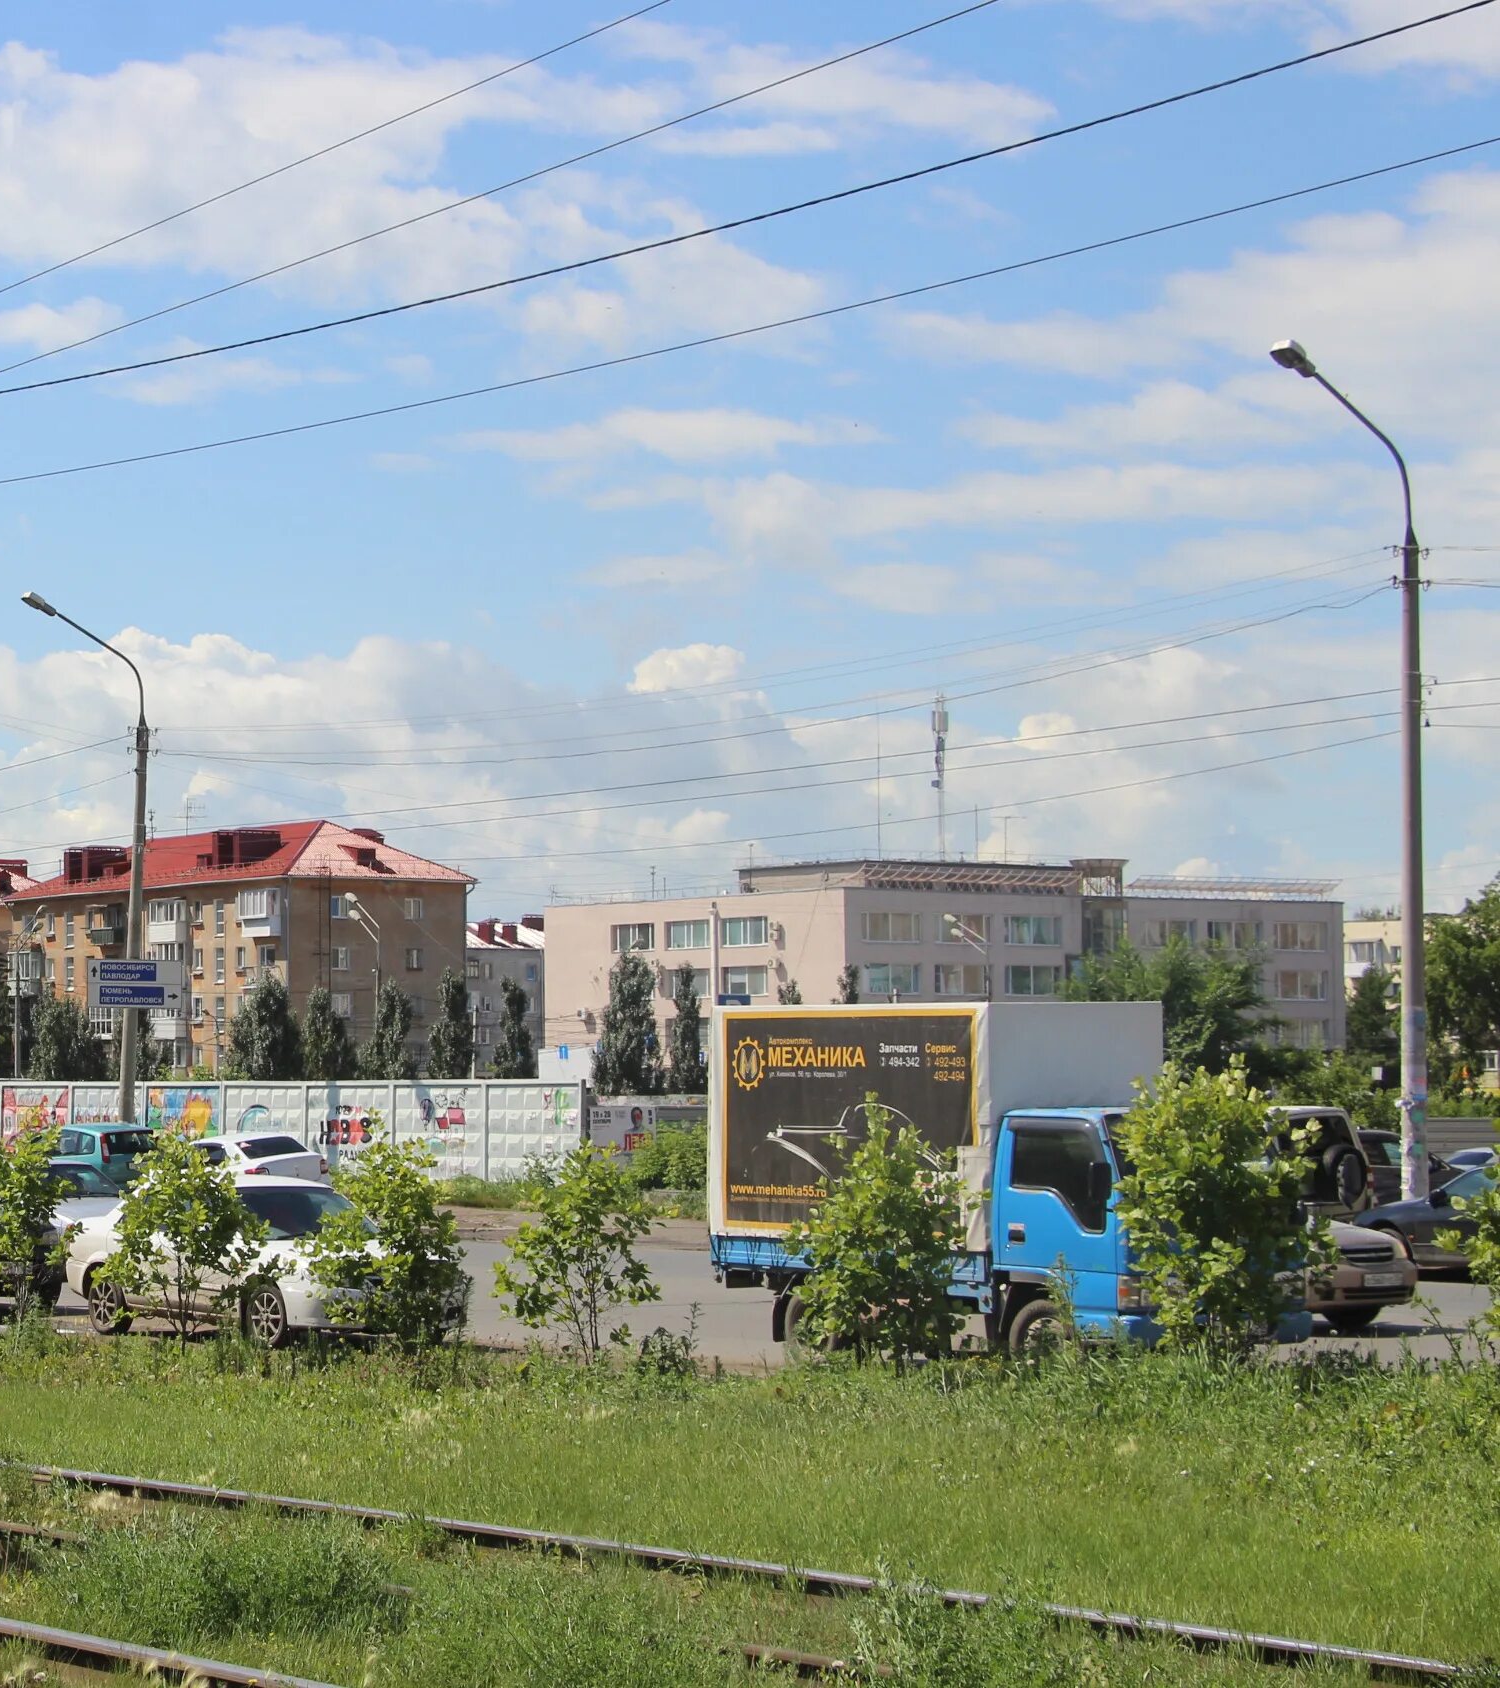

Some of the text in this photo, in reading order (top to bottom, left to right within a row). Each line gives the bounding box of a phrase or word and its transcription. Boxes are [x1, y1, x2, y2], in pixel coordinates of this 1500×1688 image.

[101, 963, 155, 971] НОВОСИБИРСК
[879, 1043, 918, 1054] Запчасти
[924, 1043, 957, 1055] Сервис
[768, 1046, 866, 1068] МЕХАНИКА
[888, 1056, 920, 1068] 494-342
[934, 1056, 966, 1068] 492-493
[933, 1071, 965, 1081] 492-494
[730, 1184, 827, 1198] www.mehanika55.ru
